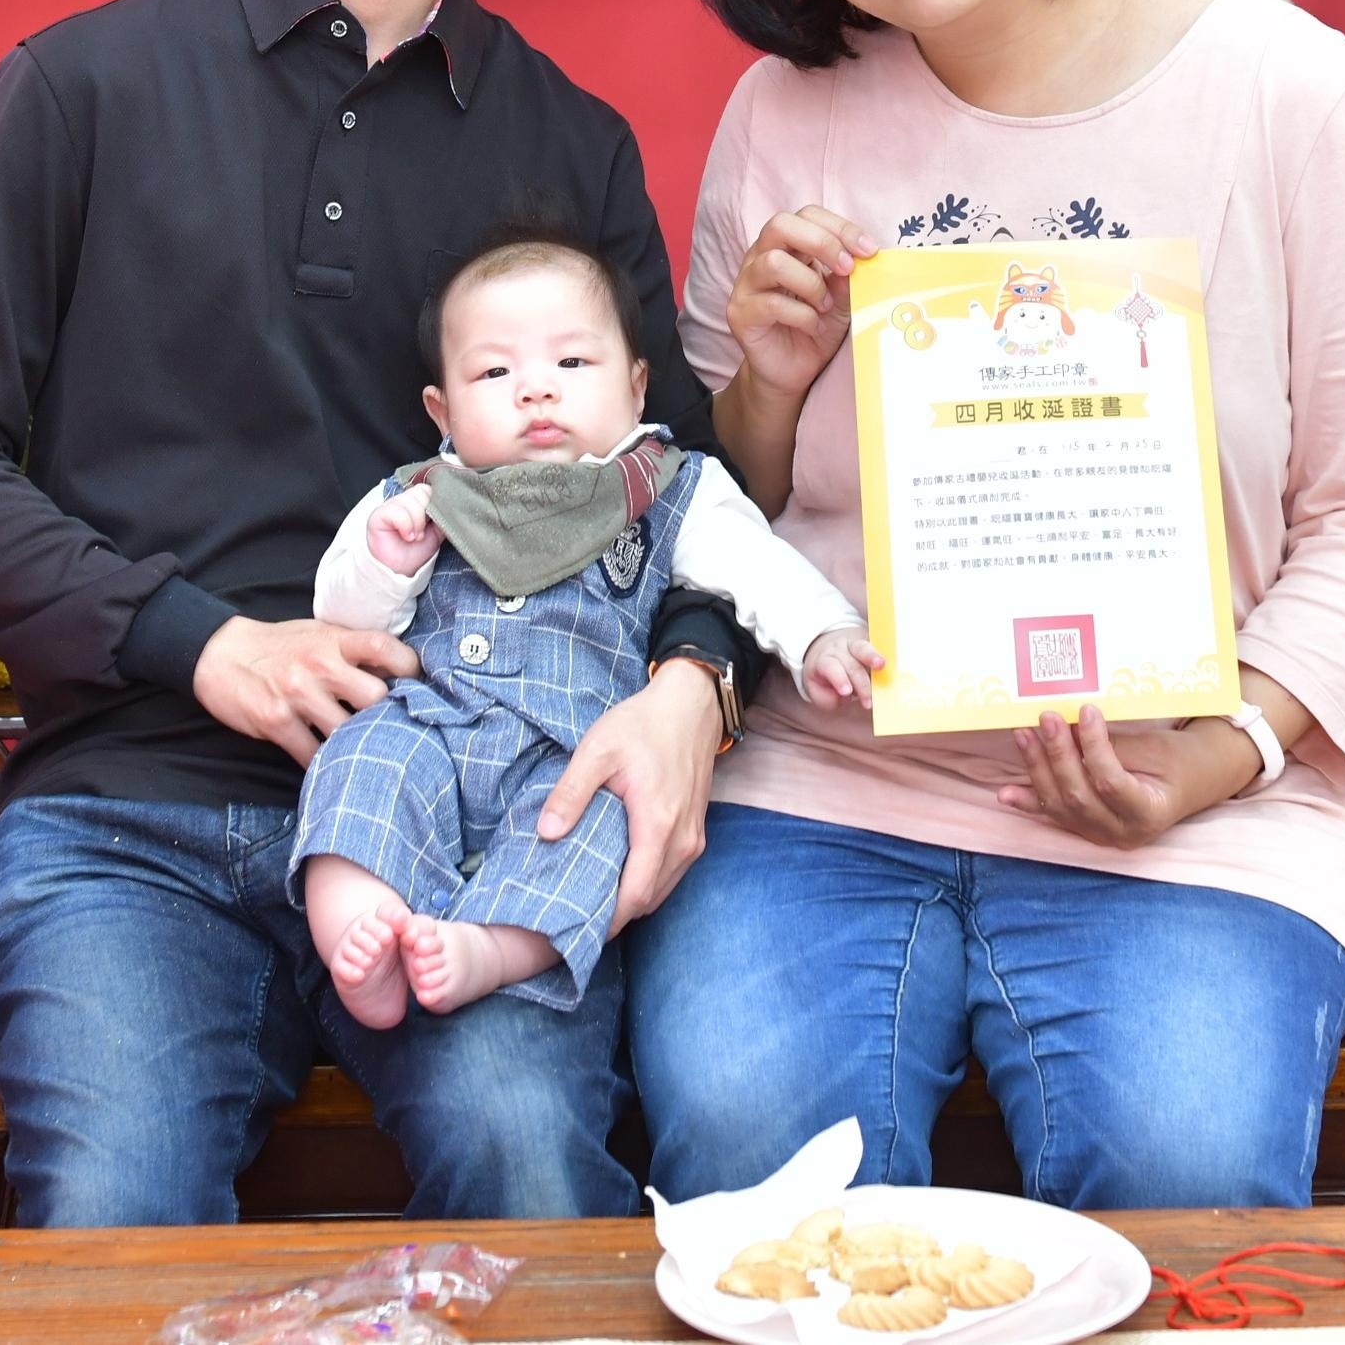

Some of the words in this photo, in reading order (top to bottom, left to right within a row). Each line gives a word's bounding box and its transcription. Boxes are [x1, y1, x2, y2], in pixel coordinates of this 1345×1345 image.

[979, 362, 1088, 382] 傳家手工印章
[954, 396, 1124, 424] 四月收涎證書
